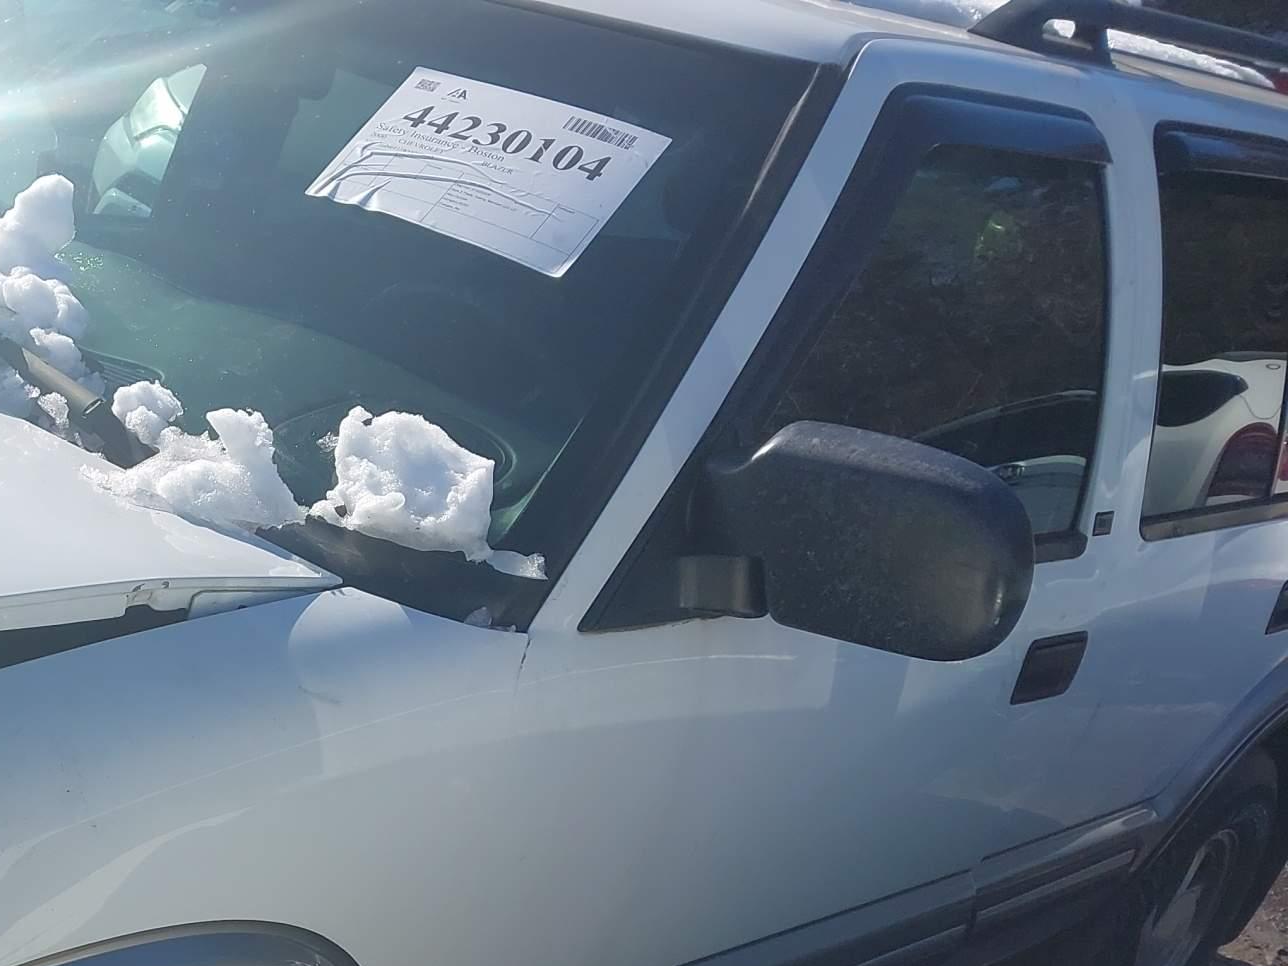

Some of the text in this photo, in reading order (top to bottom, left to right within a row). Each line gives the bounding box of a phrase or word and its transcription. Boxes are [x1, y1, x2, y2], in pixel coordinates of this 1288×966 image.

[376, 121, 409, 137] Safety
[411, 129, 460, 149] Insurance
[468, 145, 505, 162] Boston
[398, 138, 445, 154] CHEVROLET
[402, 105, 613, 182] 44230104
[481, 161, 514, 175] BLAZER
